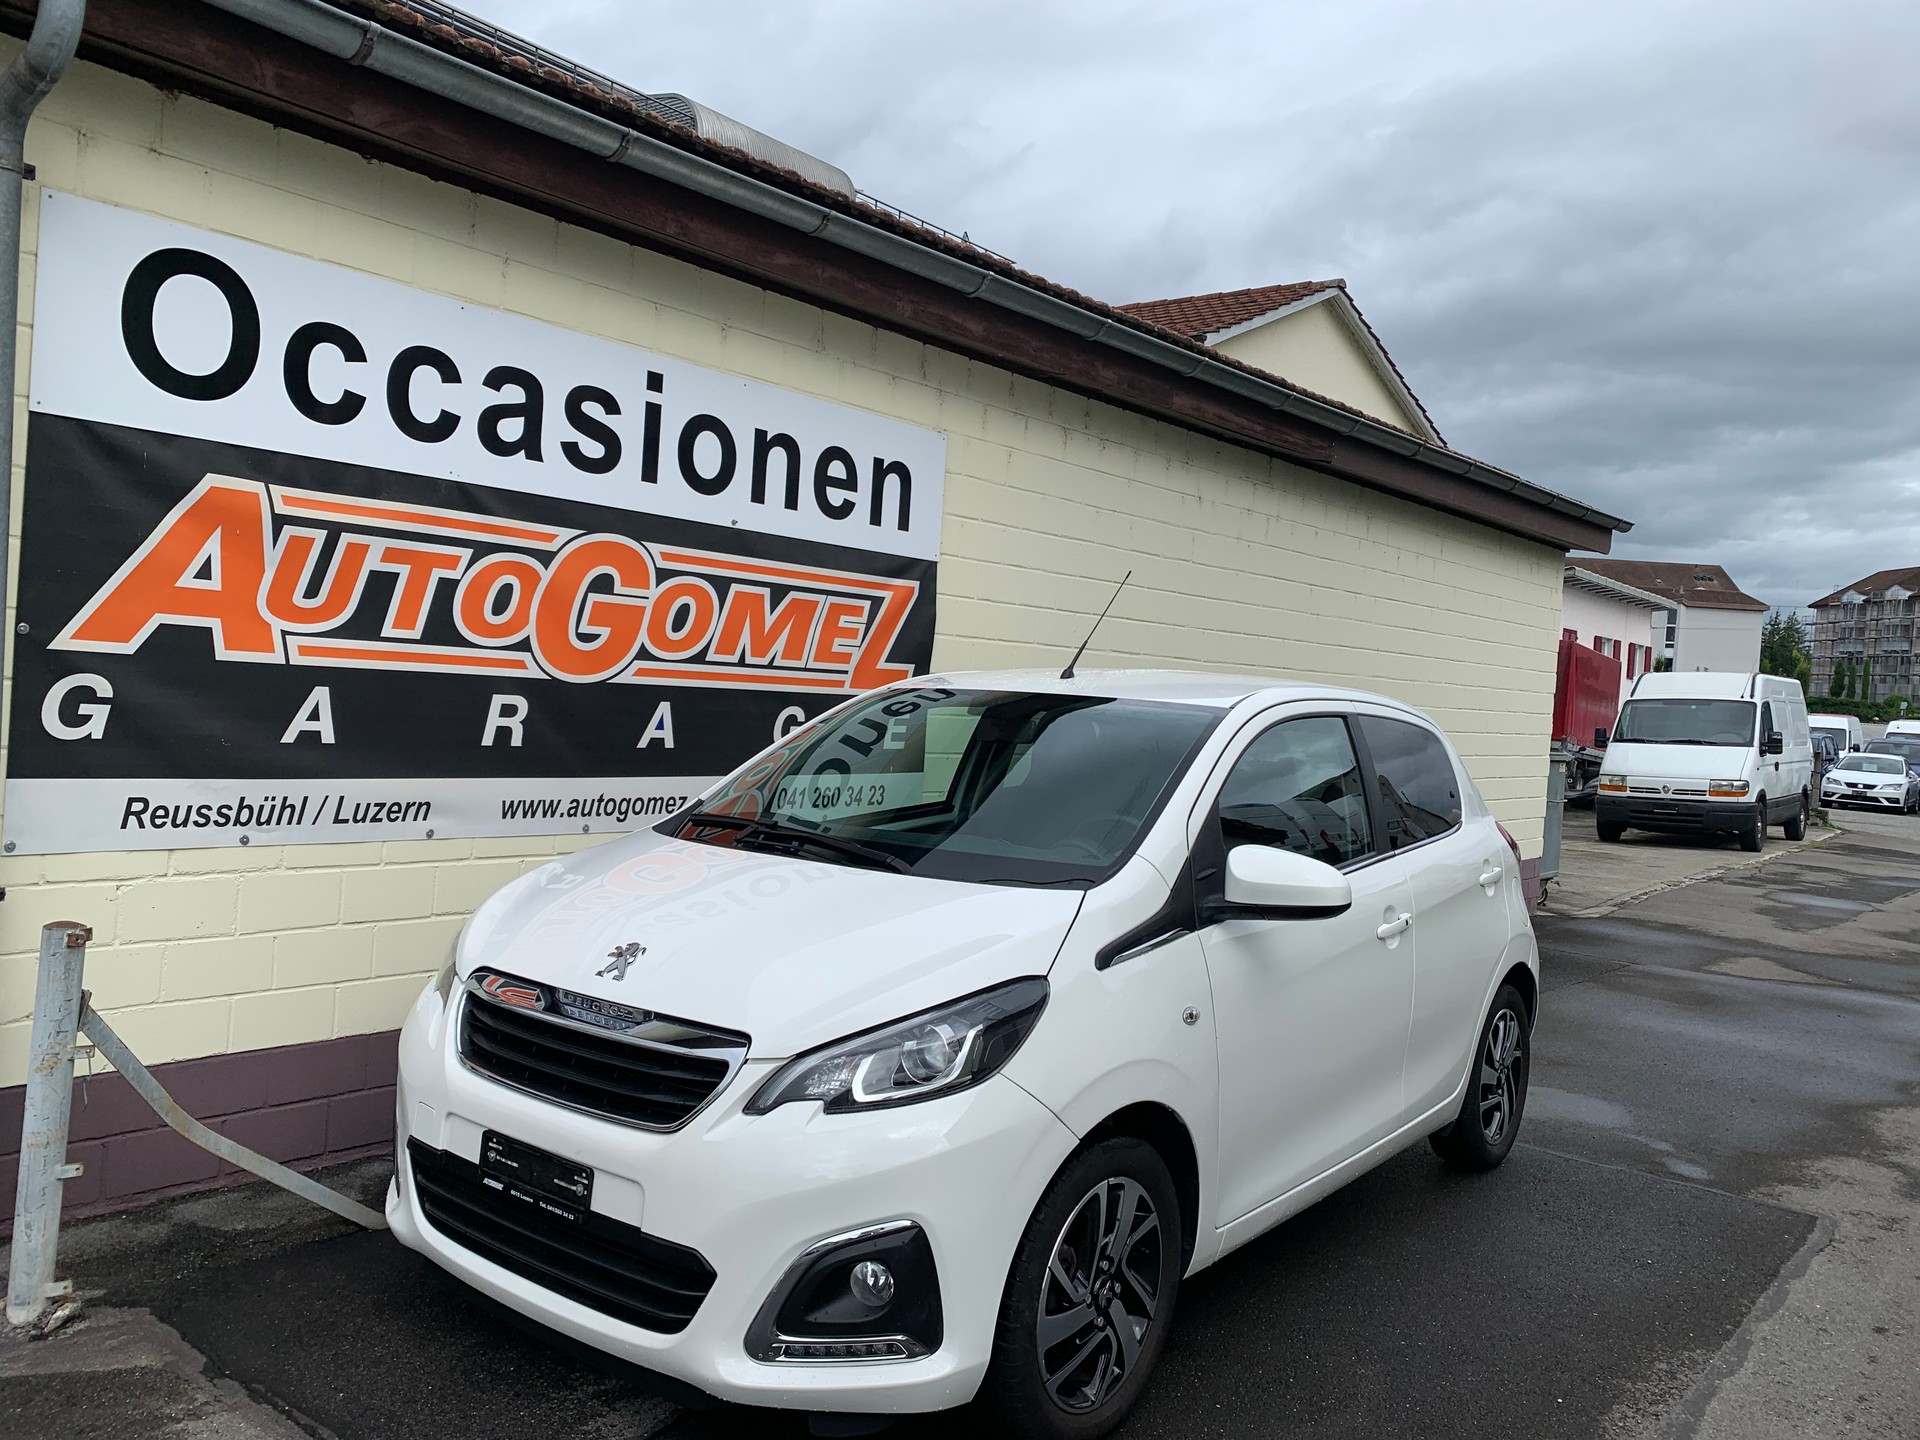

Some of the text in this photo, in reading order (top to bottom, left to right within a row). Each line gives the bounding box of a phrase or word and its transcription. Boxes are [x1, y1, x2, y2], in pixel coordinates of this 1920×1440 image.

[121, 247, 913, 532] Occasionen
[120, 796, 309, 830] Reussbühl
[332, 795, 431, 824] Luzern
[777, 784, 886, 810] 041 260 34 23
